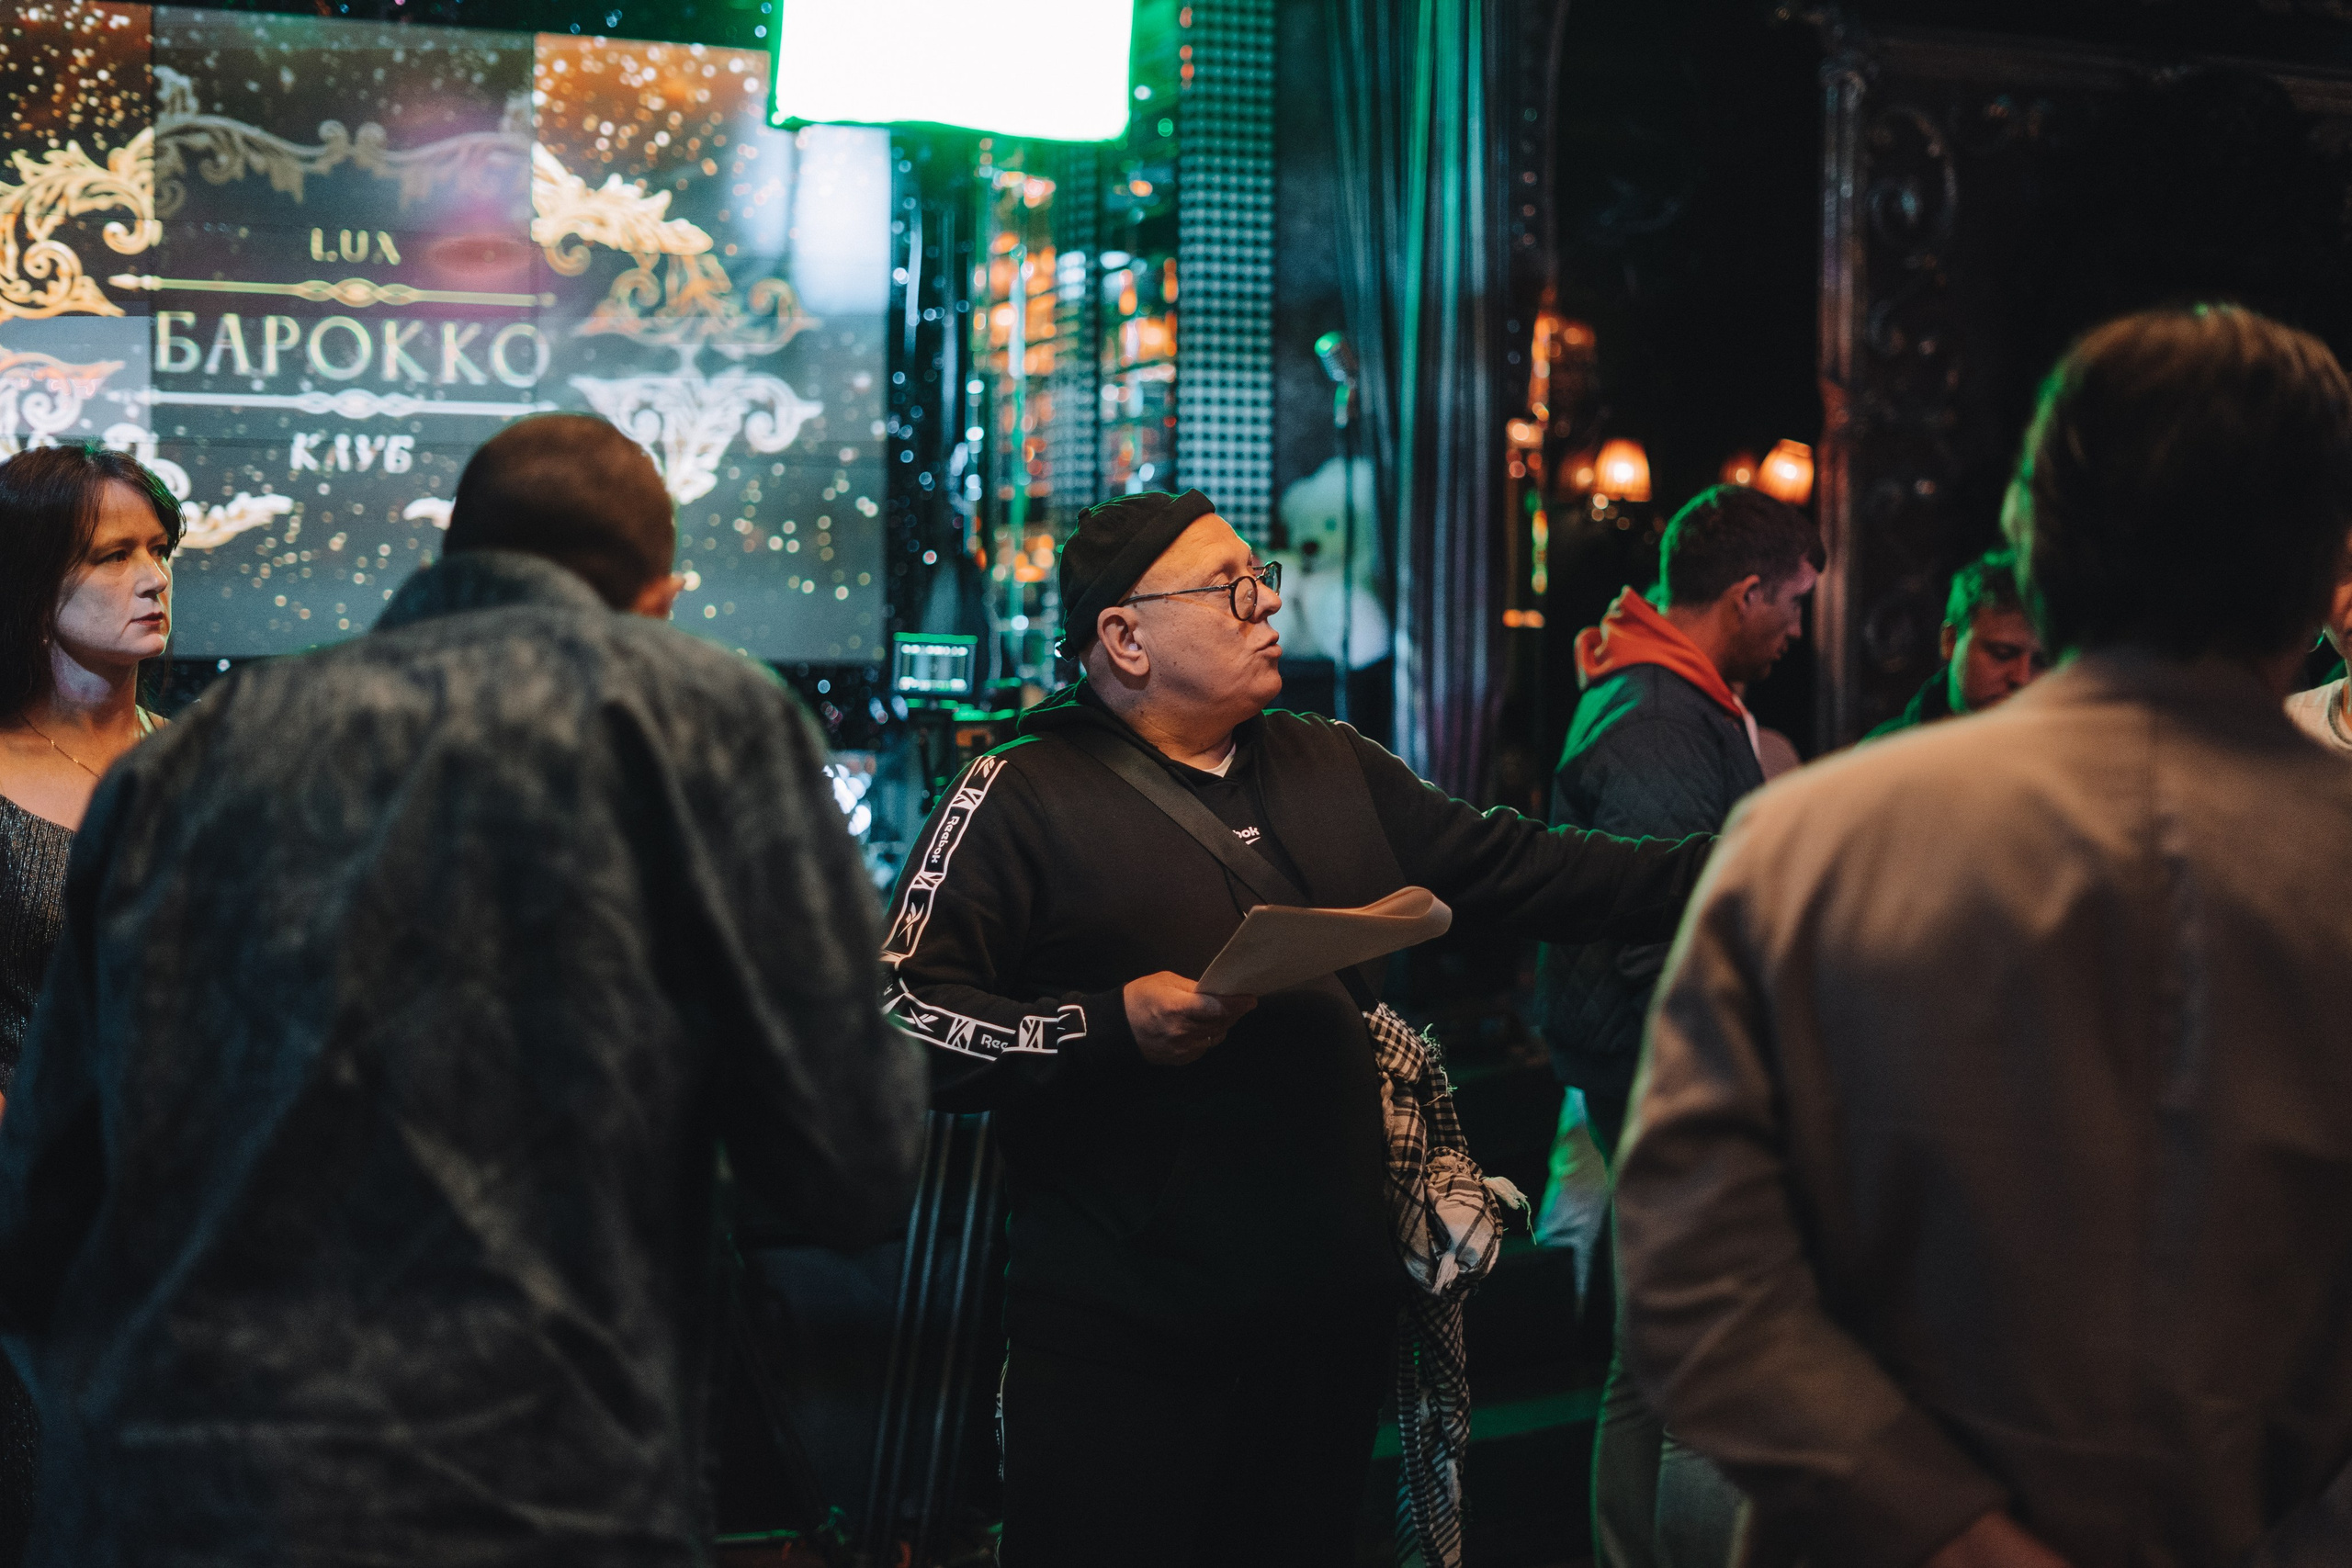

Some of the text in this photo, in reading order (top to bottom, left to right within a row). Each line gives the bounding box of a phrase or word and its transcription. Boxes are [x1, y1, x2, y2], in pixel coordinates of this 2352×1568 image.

[154, 310, 550, 389] БАРОККО
[289, 431, 415, 474] КЛУБ
[931, 816, 961, 863] Reebok
